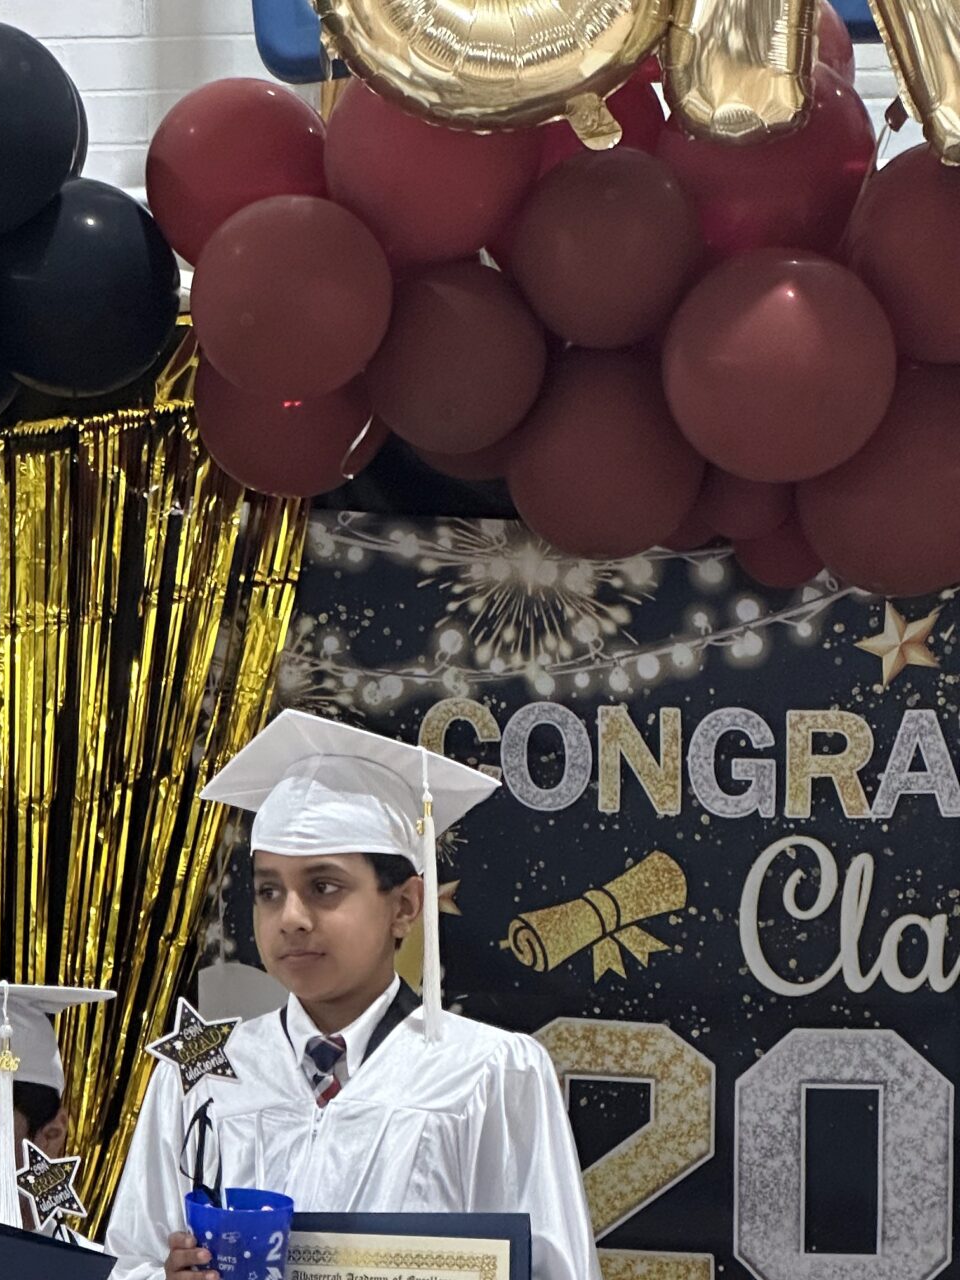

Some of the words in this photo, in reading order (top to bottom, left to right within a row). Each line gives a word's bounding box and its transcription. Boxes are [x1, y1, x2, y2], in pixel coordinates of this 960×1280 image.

[740, 835, 960, 997] Cla
[178, 1029, 222, 1063] GRAD
[217, 1254, 238, 1264] HATS
